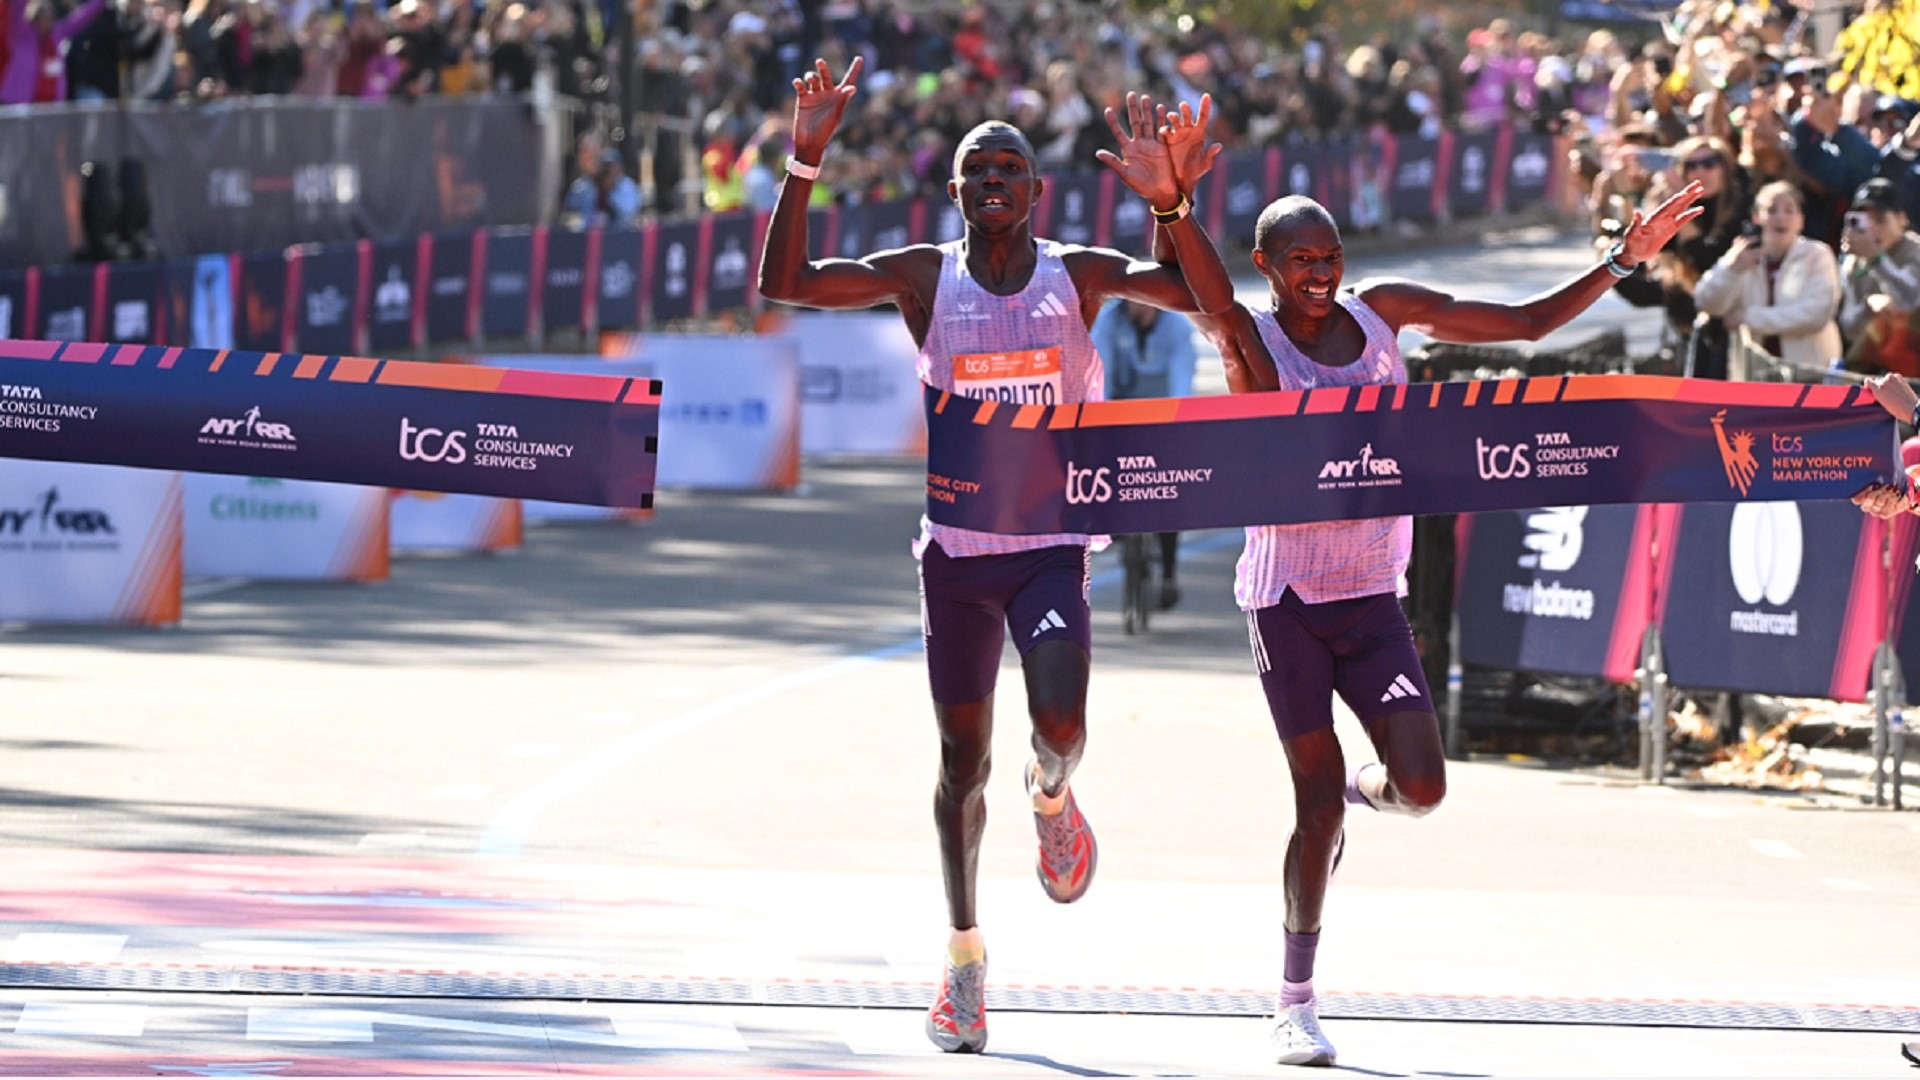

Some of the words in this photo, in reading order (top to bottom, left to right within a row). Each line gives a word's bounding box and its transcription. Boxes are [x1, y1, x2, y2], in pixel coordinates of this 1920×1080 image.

[965, 357, 989, 374] tcs
[1, 384, 42, 400] TATA
[0, 400, 98, 420] CONSULTANCY
[0, 414, 61, 433] SERVICES
[476, 423, 519, 439] TATA
[400, 416, 467, 465] tcs
[1535, 432, 1571, 446] TATA
[1772, 432, 1804, 453] tcs
[474, 438, 574, 458] CONSULTANCY
[1535, 446, 1620, 462] CONSULTANCY
[473, 453, 537, 471] SERVICES
[1117, 455, 1157, 470] TATA
[1476, 436, 1531, 480] tcs
[1772, 457, 1803, 469] NEW
[1806, 456, 1841, 468] YORK
[1843, 456, 1873, 468] CITY
[1117, 468, 1213, 486] CONSULTANCY
[1536, 462, 1589, 478] SERVICES
[1772, 470, 1848, 481] MARATHON
[927, 473, 952, 489] ORK
[951, 479, 981, 495] CITY
[1066, 461, 1113, 505] tcs
[1118, 485, 1179, 502] SERVICES
